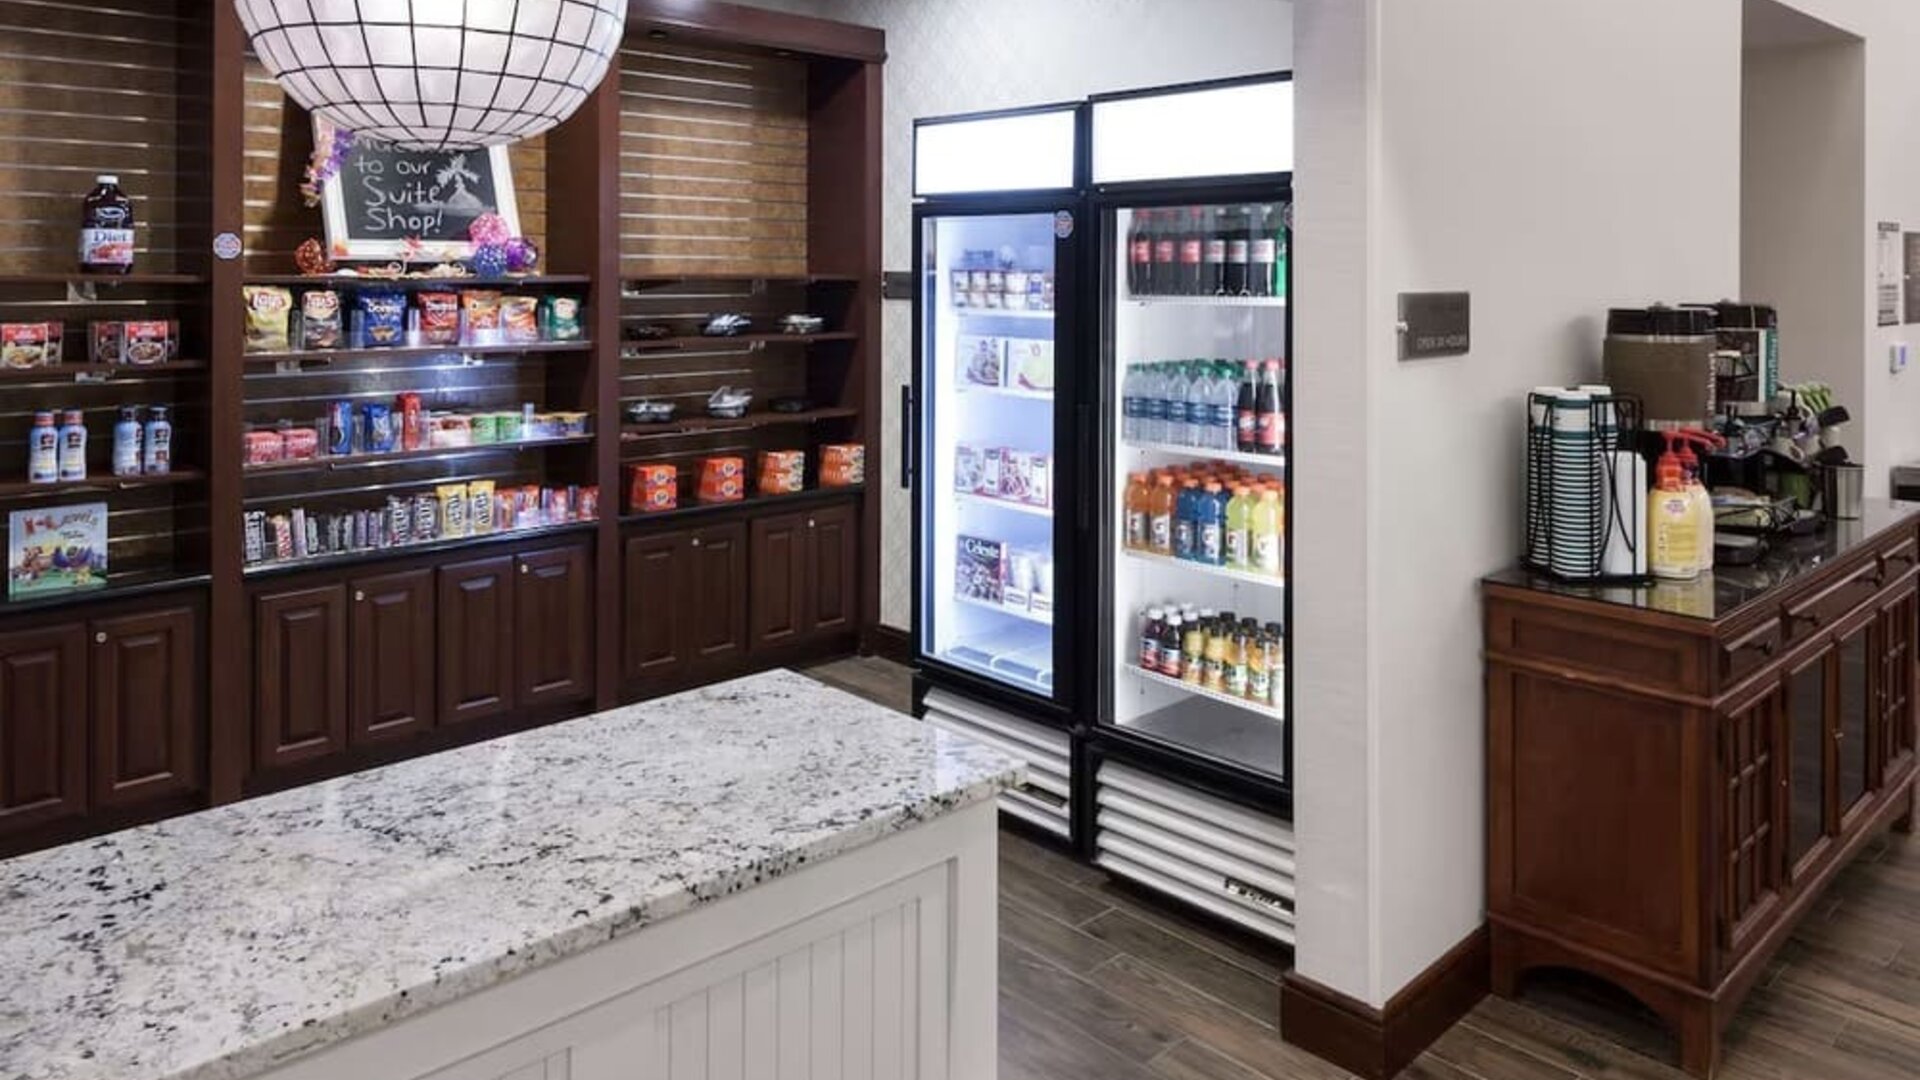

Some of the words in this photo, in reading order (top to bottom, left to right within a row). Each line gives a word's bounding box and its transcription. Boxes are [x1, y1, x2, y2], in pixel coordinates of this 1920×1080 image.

[354, 155, 384, 174] to
[396, 160, 431, 174] our
[362, 175, 441, 207] Suite
[364, 207, 443, 236] Shop!
[94, 230, 127, 242] Diet
